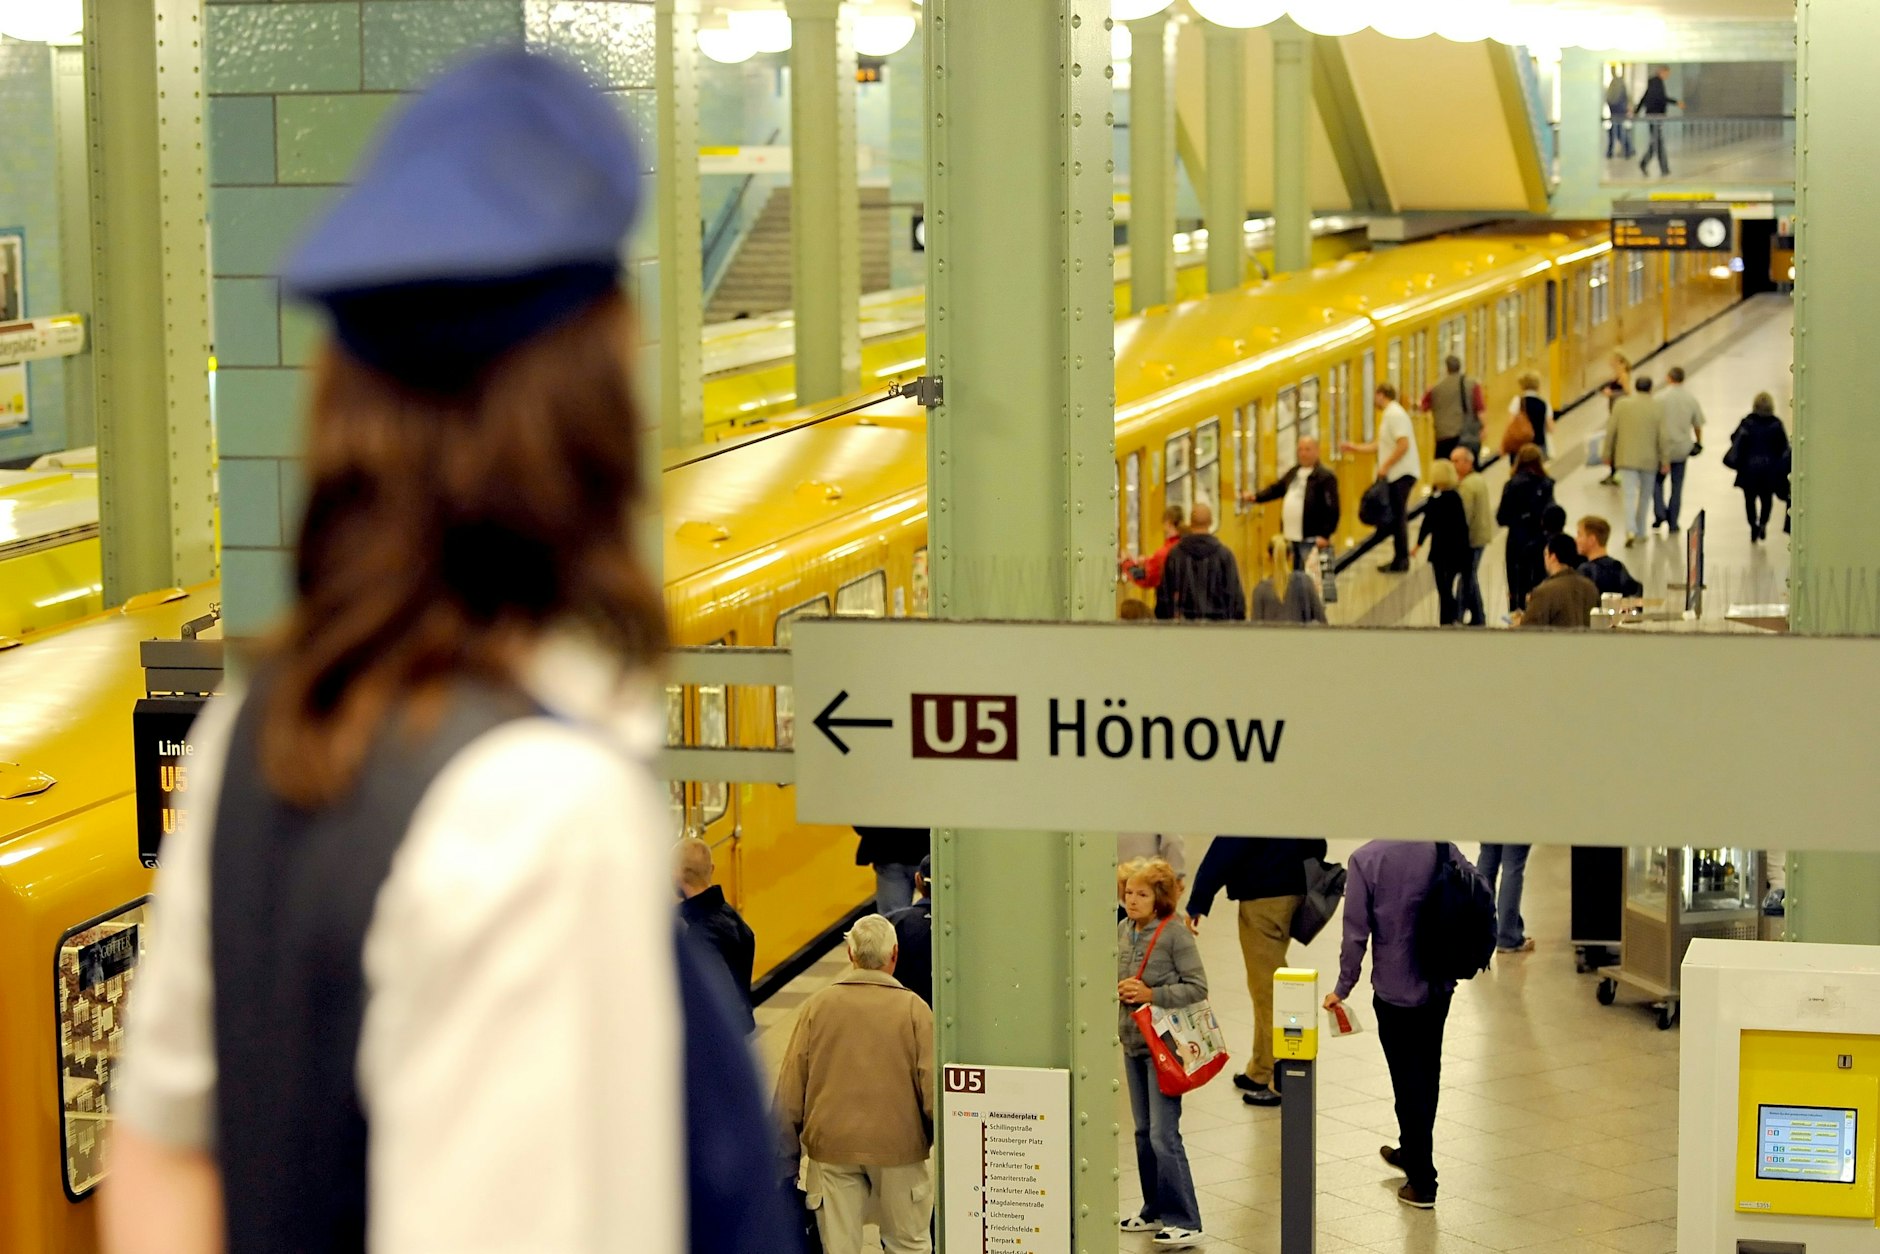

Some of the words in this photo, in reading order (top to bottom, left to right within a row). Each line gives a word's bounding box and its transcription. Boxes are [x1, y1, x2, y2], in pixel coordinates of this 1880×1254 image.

[922, 699, 1008, 754] U5
[1049, 697, 1285, 763] Hönow
[158, 740, 194, 756] Linie
[160, 765, 188, 792] U5
[100, 934, 132, 959] GÖTTER
[949, 1069, 982, 1092] U5
[989, 1111, 1037, 1120] Alexanderplatz
[989, 1123, 1033, 1132] Schillingstraße
[989, 1136, 1027, 1145] Strausberger
[989, 1149, 1026, 1157] Weberwiese
[989, 1161, 1023, 1169] Frankfurter
[989, 1173, 1037, 1182] Samariterstraße
[990, 1186, 1023, 1194] Frankfurter
[990, 1199, 1045, 1208] Magdalenenstraße
[990, 1211, 1025, 1220] Lichtenberg
[990, 1224, 1033, 1233] Friedrichsfelde
[990, 1236, 1015, 1244] Tierpark
